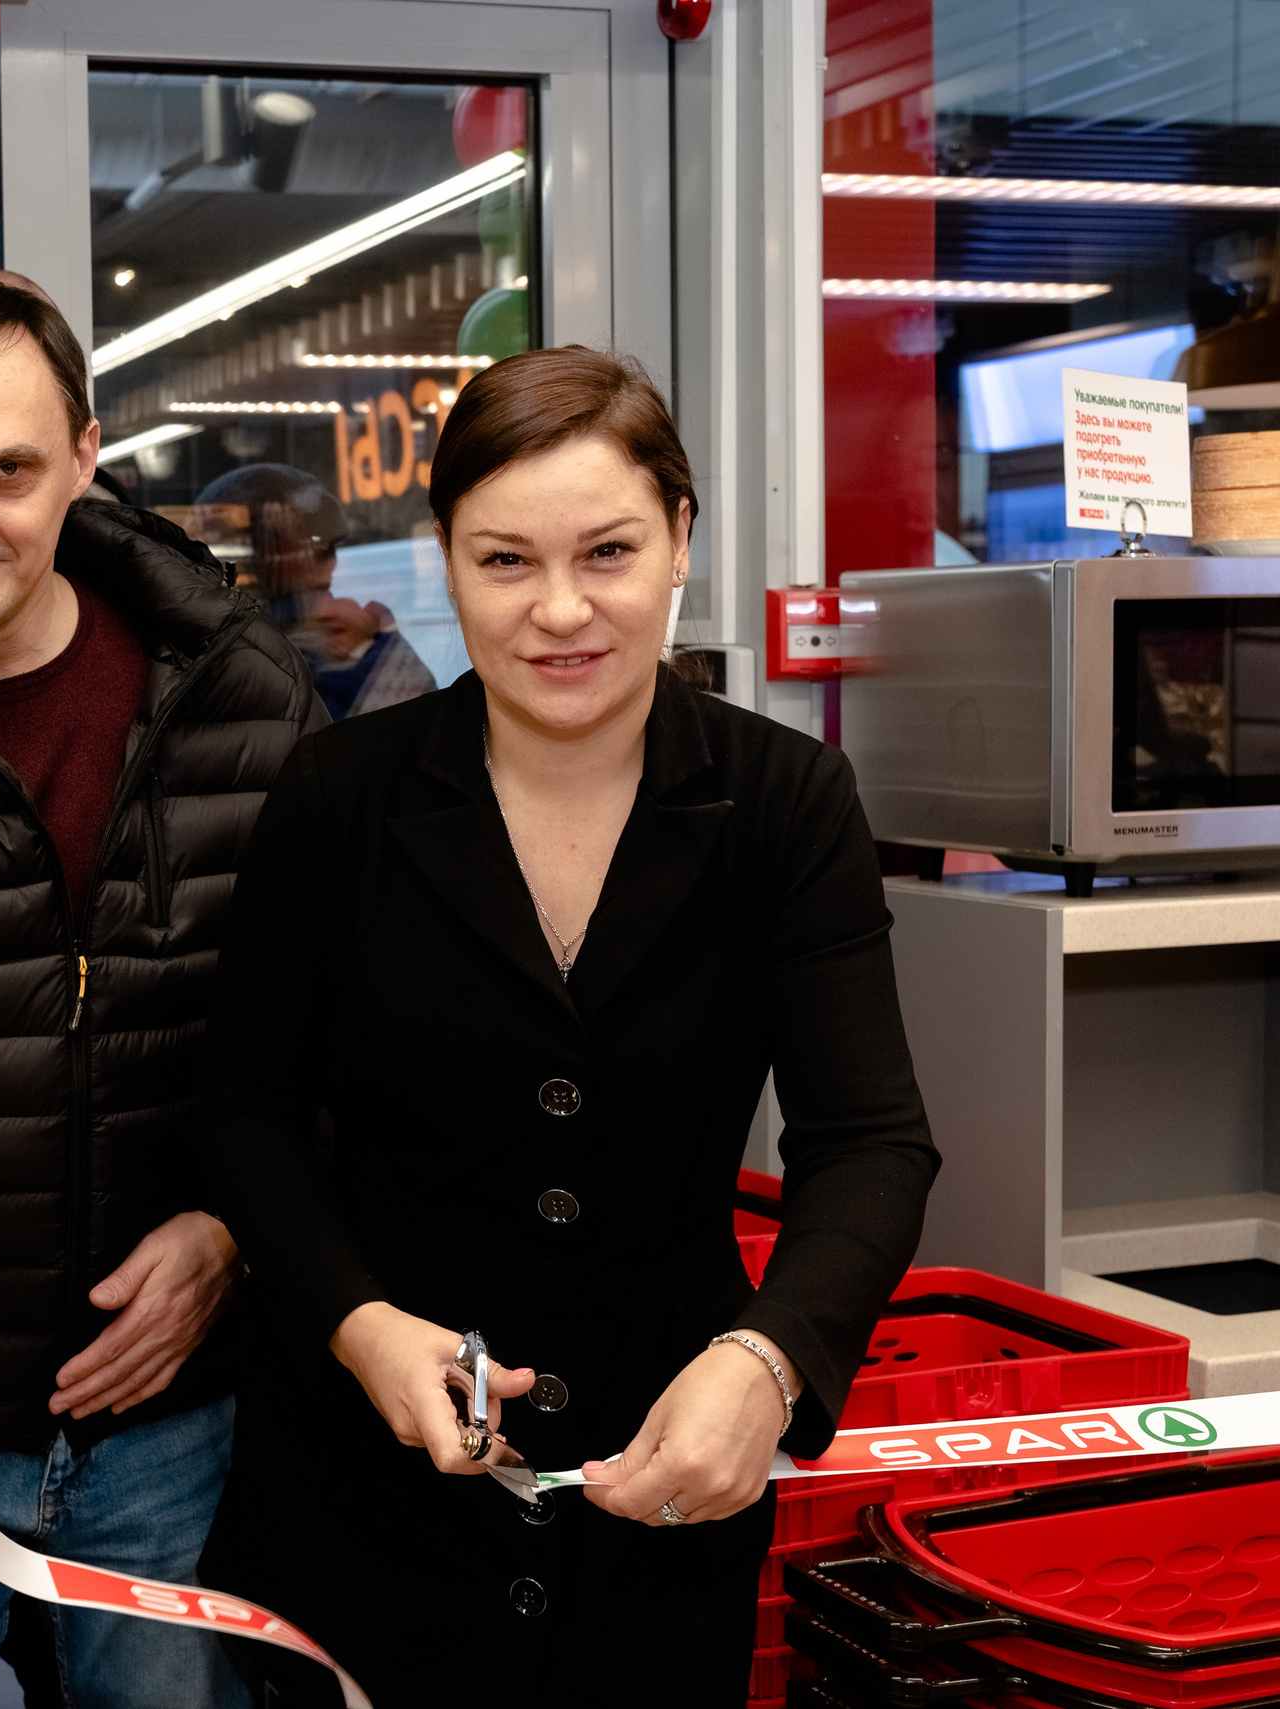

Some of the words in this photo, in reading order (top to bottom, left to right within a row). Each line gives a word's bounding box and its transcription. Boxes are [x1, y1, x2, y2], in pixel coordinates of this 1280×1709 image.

[1074, 388, 1127, 409] Уважаемые
[1129, 399, 1184, 415] покупатели!
[1075, 410, 1101, 426] Здесь
[1103, 416, 1115, 428] вы
[1117, 418, 1152, 433] можете
[1076, 430, 1121, 447] подогреть
[1077, 448, 1146, 468] приобретенную
[1077, 466, 1083, 479] у
[1084, 469, 1100, 479] нас
[1102, 469, 1154, 485] продукцию.
[1078, 490, 1106, 502] Желаем
[1156, 500, 1188, 510] аппетита!
[1114, 825, 1179, 836] MENUMASTER
[870, 1420, 1129, 1466] SPAR
[130, 1583, 282, 1634] SP
